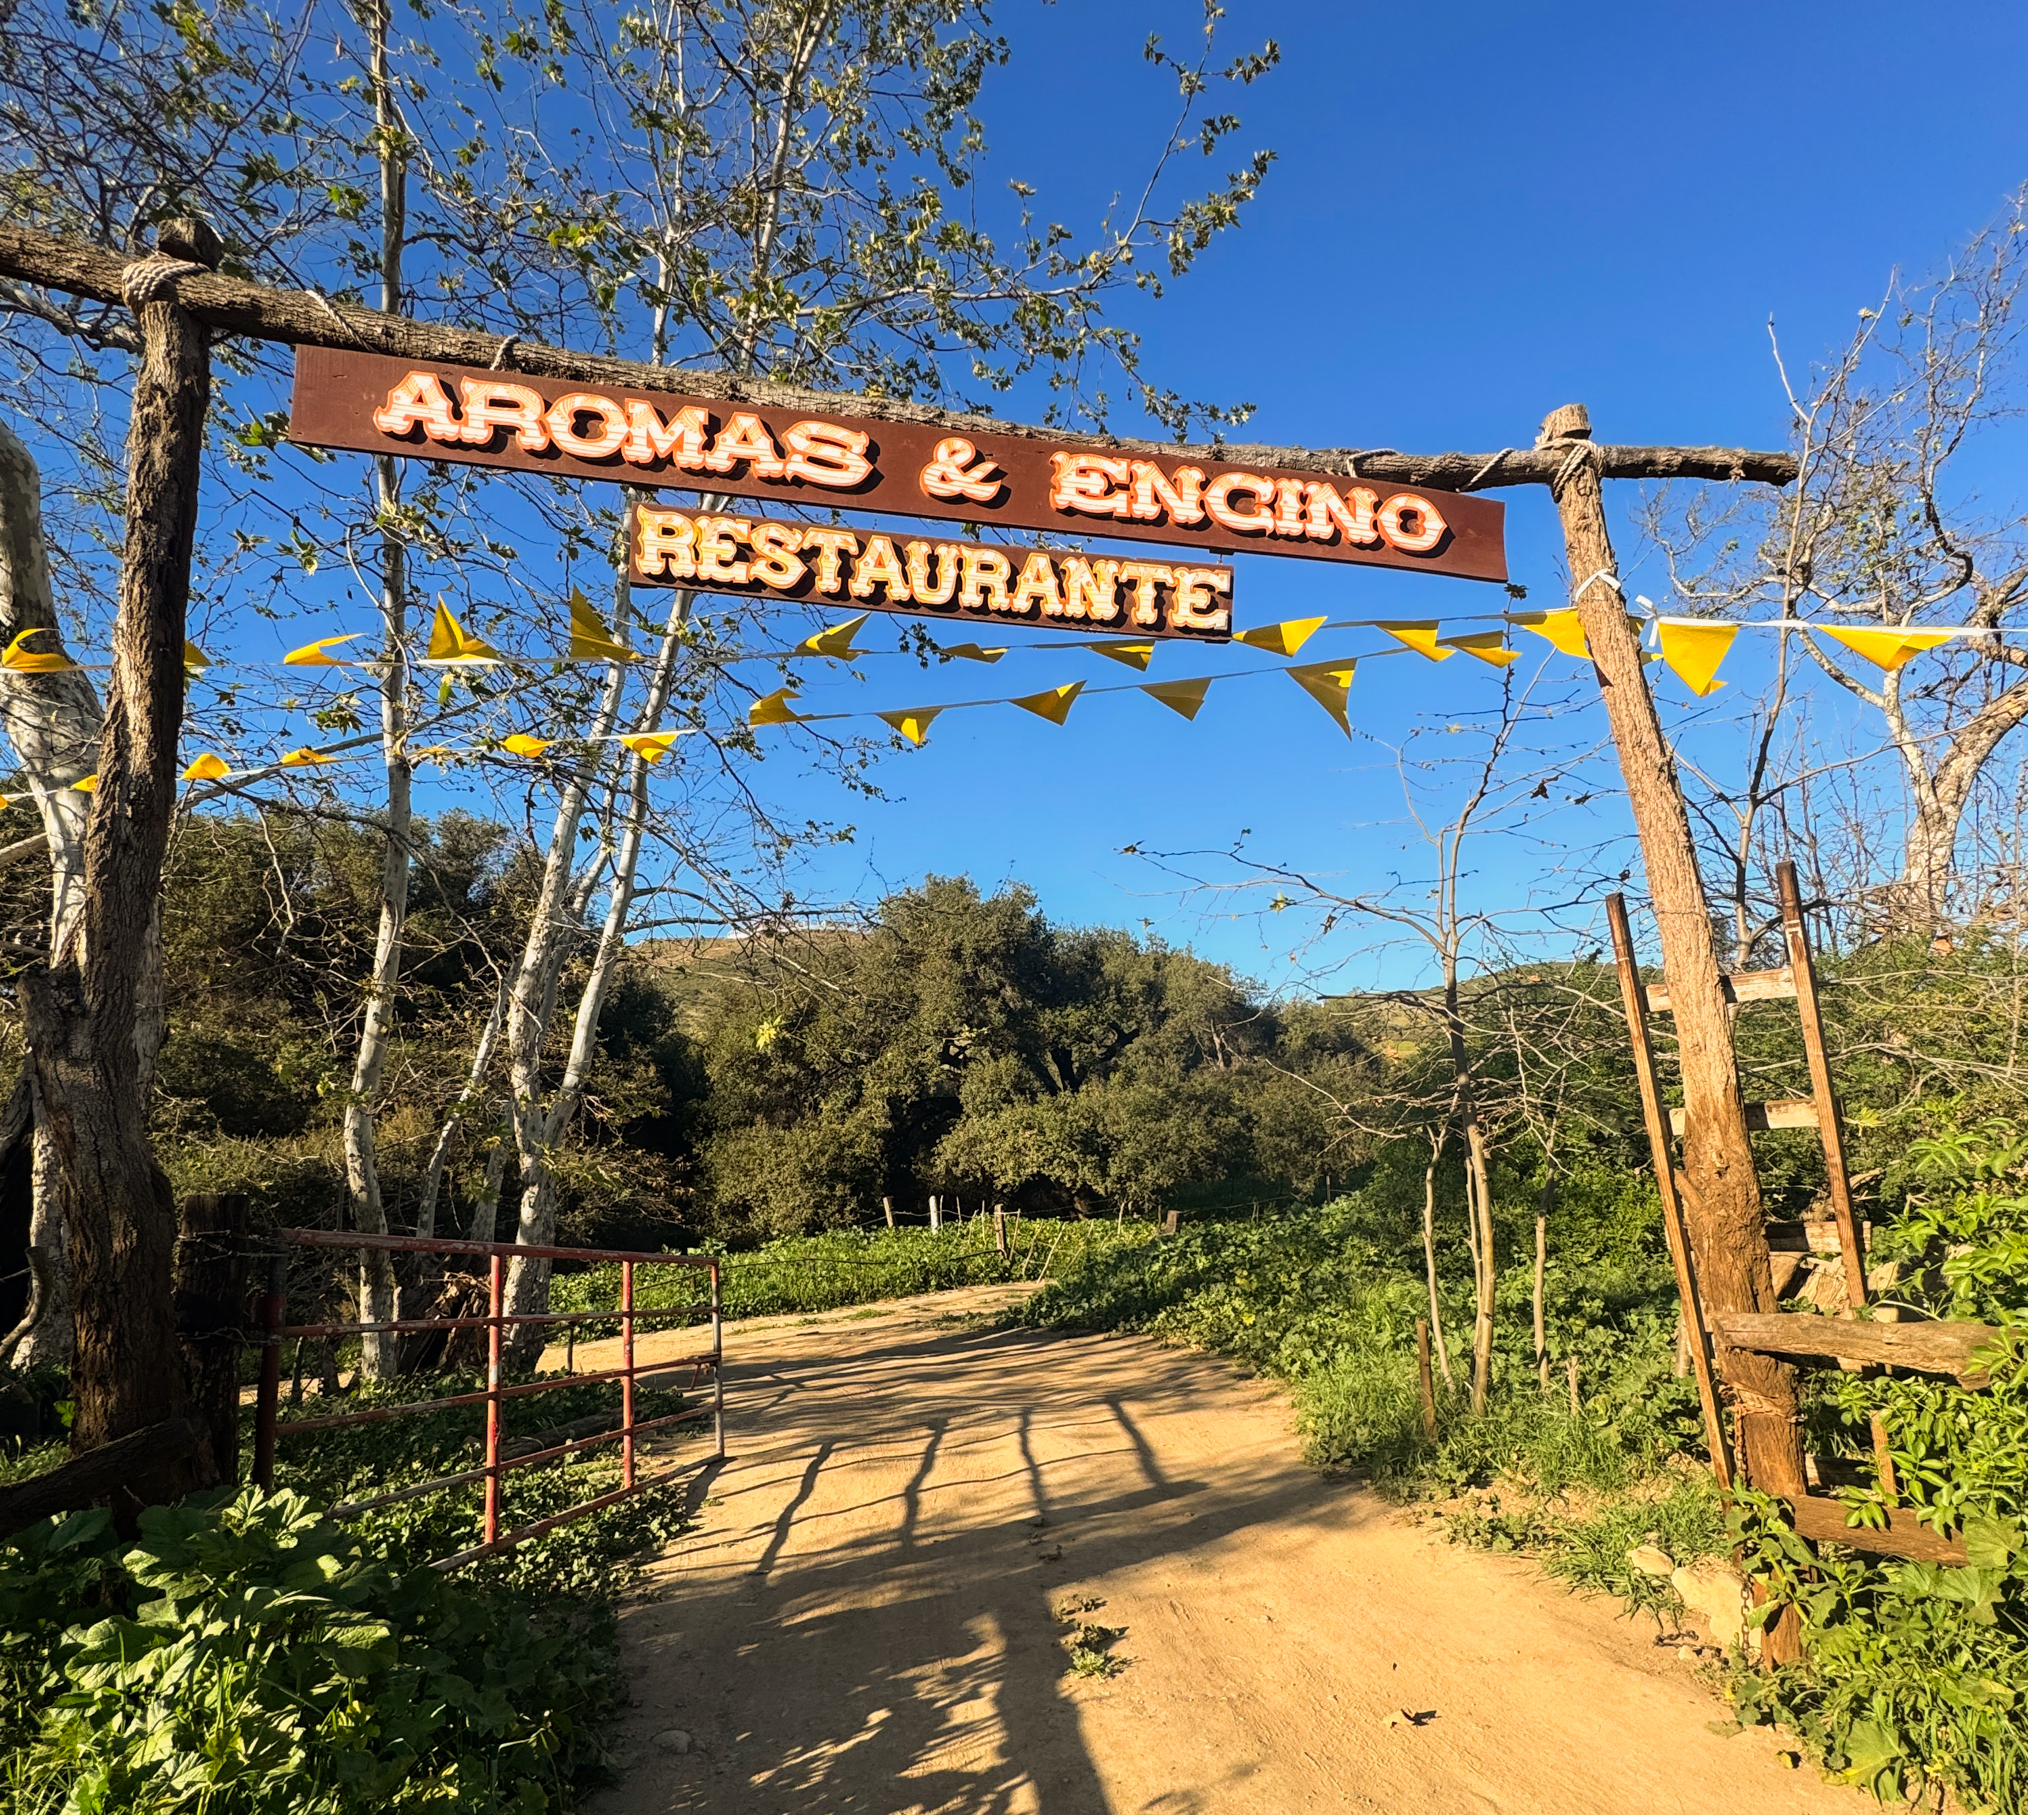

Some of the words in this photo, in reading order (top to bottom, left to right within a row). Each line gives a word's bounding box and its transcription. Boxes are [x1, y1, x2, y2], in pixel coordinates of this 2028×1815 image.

[374, 370, 874, 487] AROMAS
[920, 438, 1000, 501] &
[1050, 451, 1448, 552] ENCINO
[635, 504, 1231, 630] RESTAURANTE
